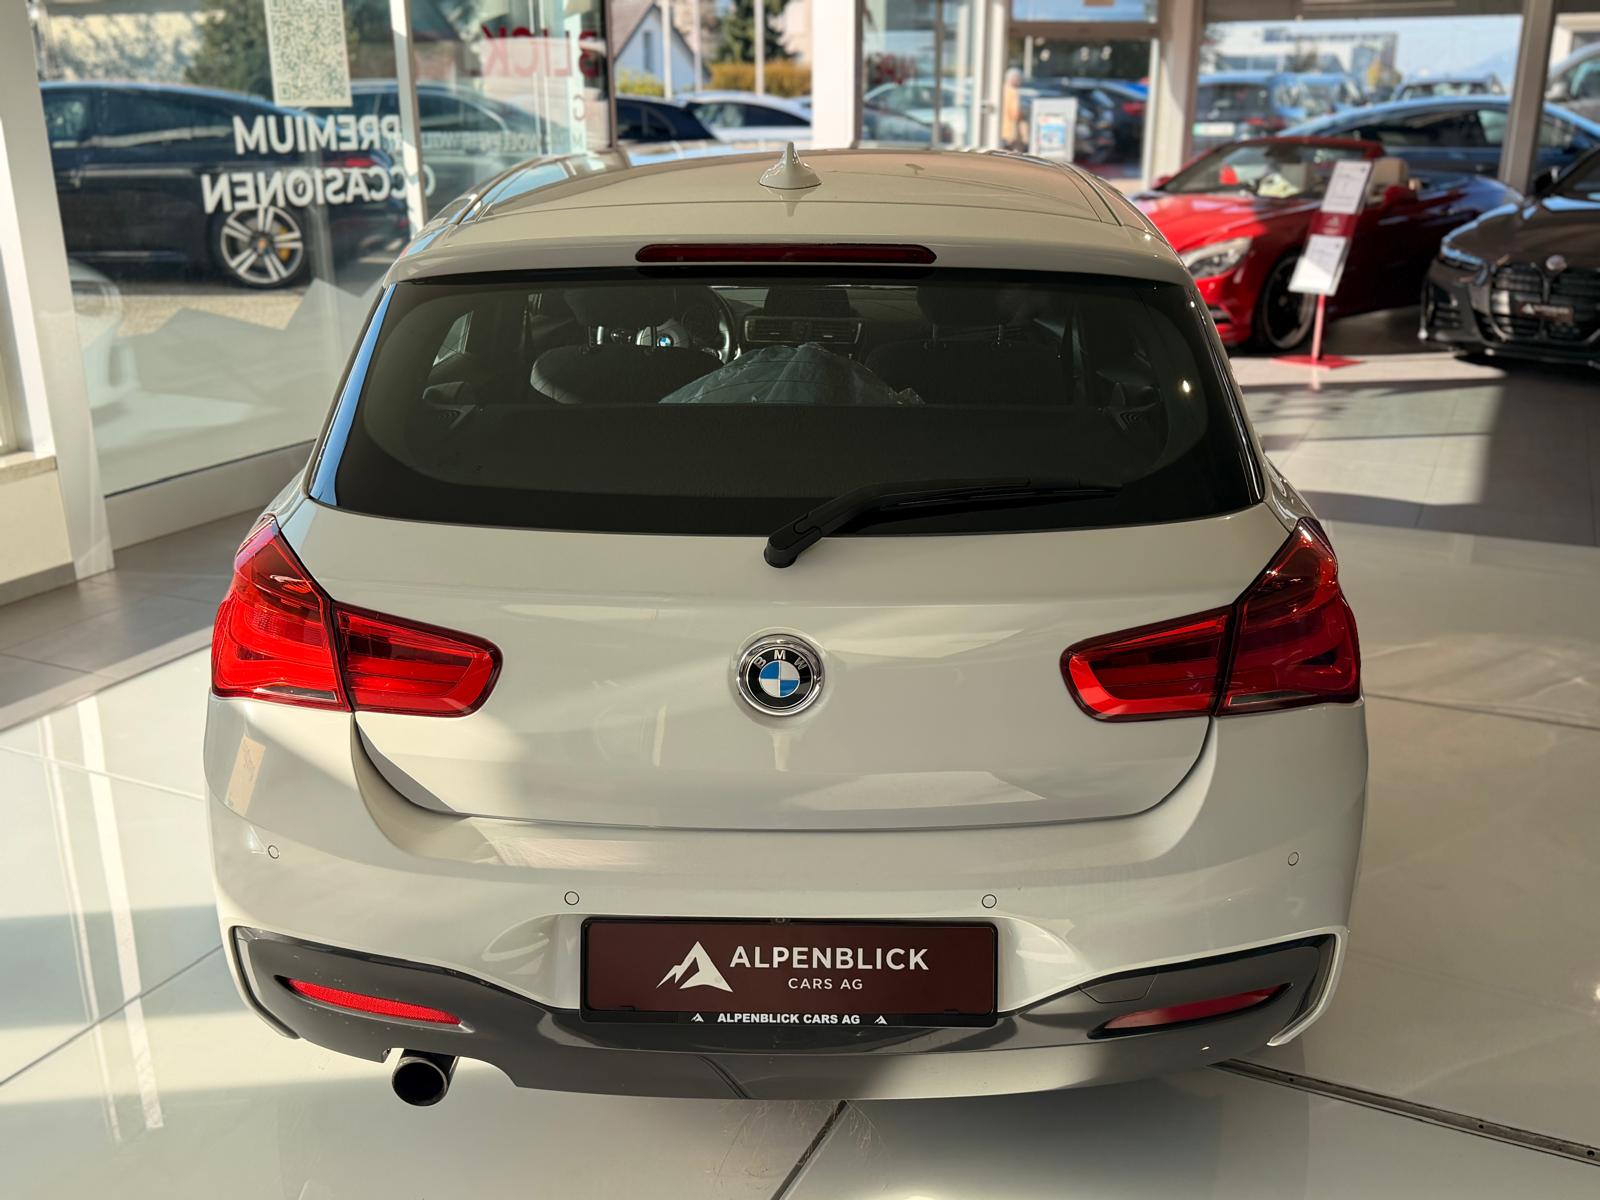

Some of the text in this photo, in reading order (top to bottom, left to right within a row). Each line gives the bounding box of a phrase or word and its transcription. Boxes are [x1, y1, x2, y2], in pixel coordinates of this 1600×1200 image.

[730, 945, 930, 971] ALPENBLICK
[788, 978, 863, 991] CARS AG
[717, 1012, 861, 1025] ALPENBLICK CARS AG
